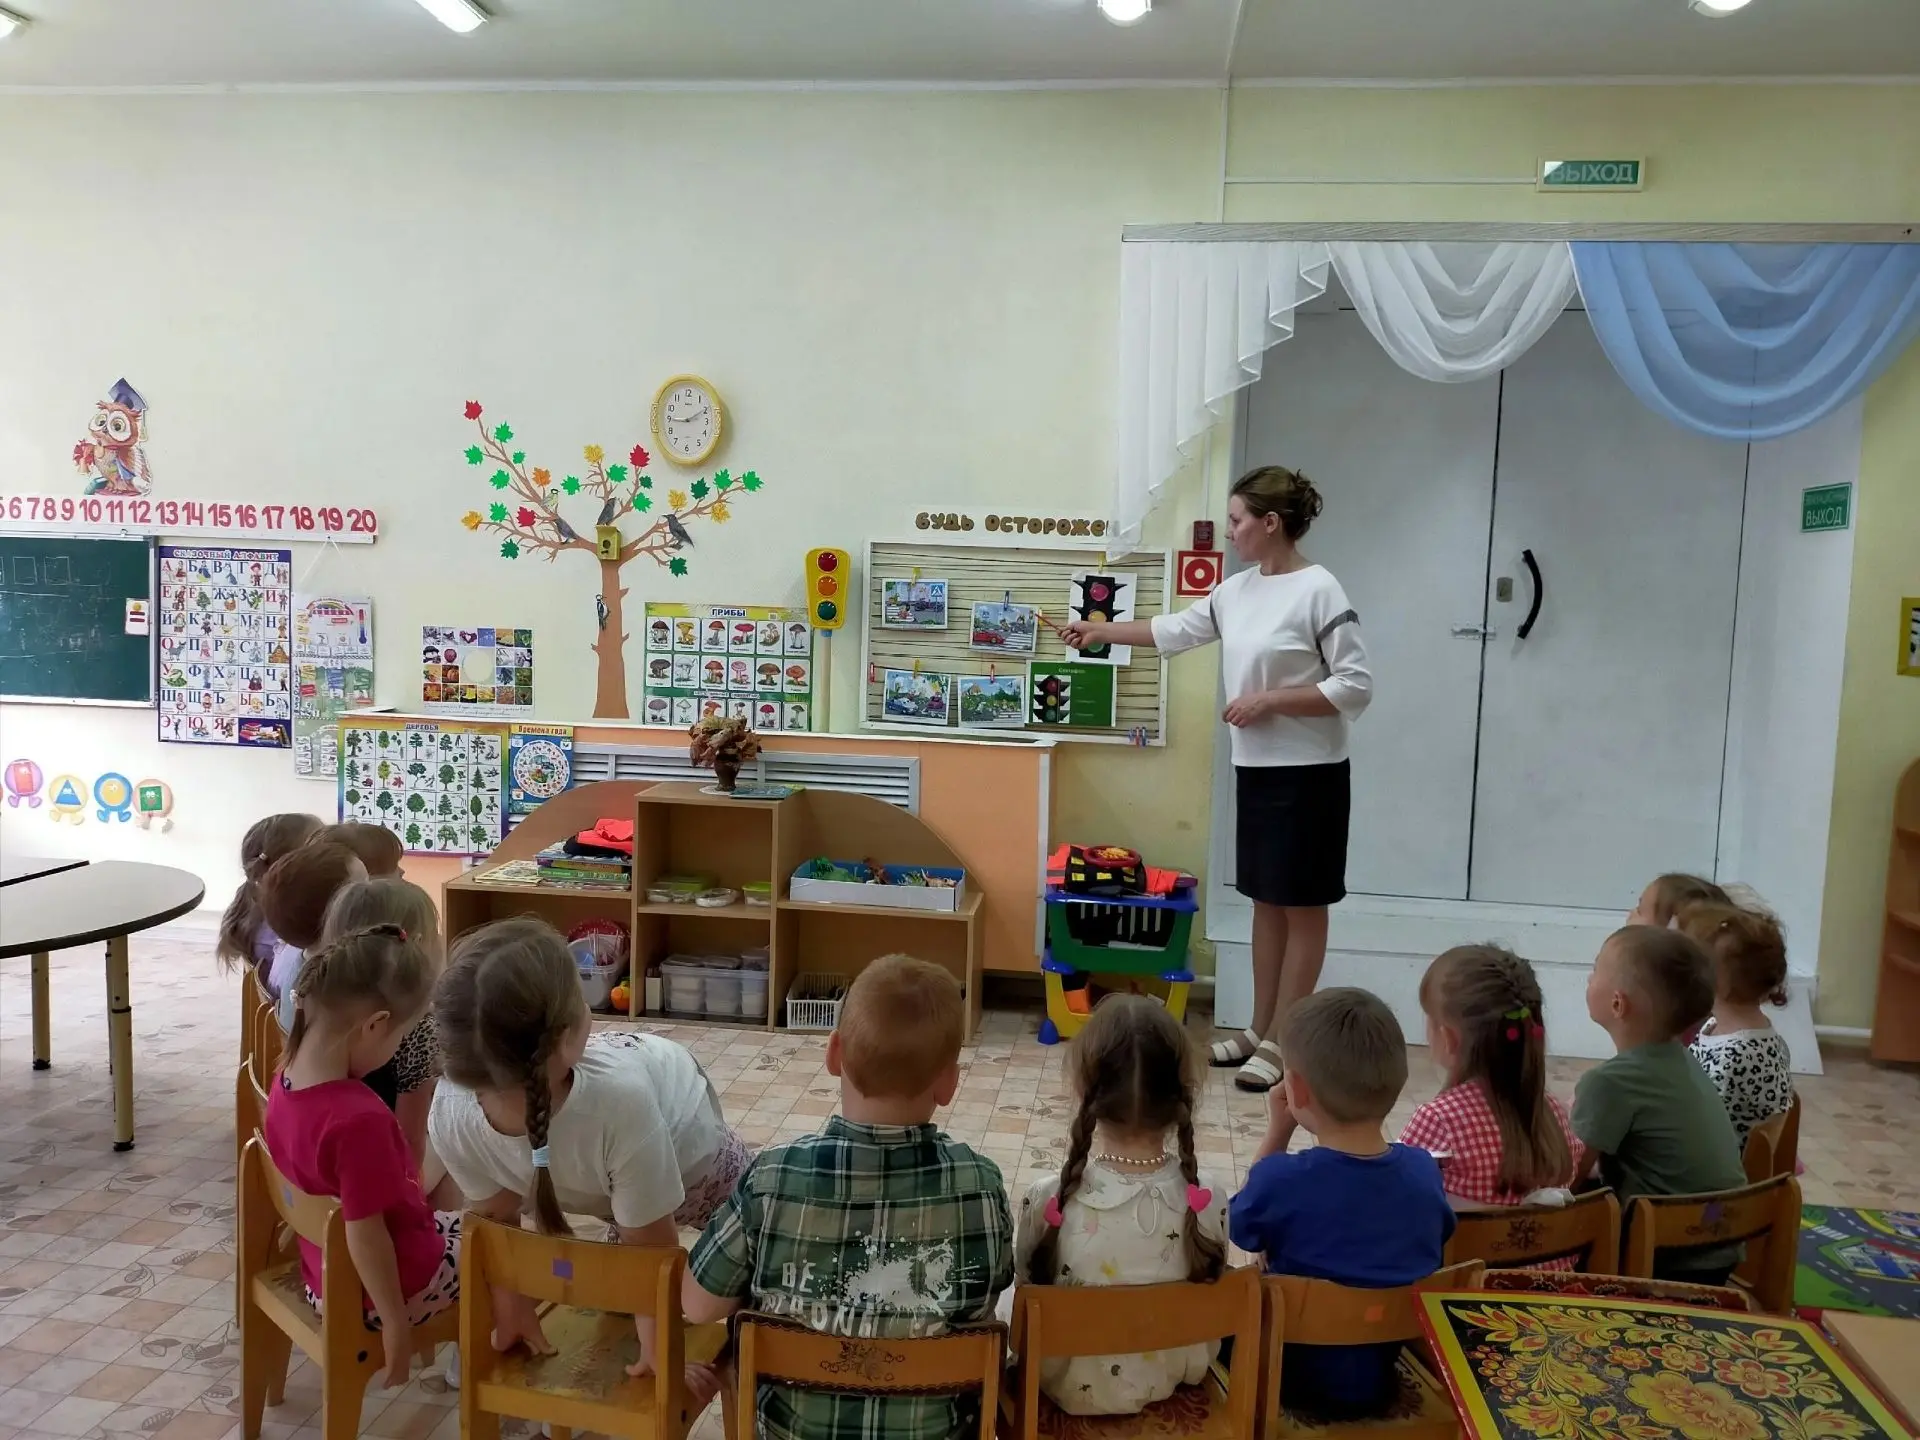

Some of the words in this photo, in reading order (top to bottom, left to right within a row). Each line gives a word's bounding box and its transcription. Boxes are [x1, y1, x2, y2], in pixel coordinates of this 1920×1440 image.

[1550, 164, 1633, 182] ВЫХОД
[9, 497, 22, 519] 6
[27, 498, 40, 520] 7
[44, 498, 56, 520] 8
[61, 499, 74, 521] 9
[79, 499, 102, 522] 10
[106, 500, 124, 523] 11
[128, 501, 152, 523] 12
[155, 501, 178, 525] 13
[182, 502, 203, 526] 14
[208, 504, 232, 527] 15
[235, 505, 257, 528] 16
[262, 506, 284, 529] 17
[290, 506, 315, 530] 18
[318, 508, 343, 531] 19
[347, 509, 377, 533] 20
[1806, 506, 1842, 526] ВЫХОД
[233, 551, 279, 560] АЛФАВИТ
[162, 561, 172, 571] А
[188, 560, 197, 572] Б
[214, 561, 222, 573] В
[240, 562, 248, 574] Г
[264, 563, 275, 576] Д
[162, 586, 171, 598] Е
[214, 588, 226, 600] Ж
[240, 589, 247, 600] З
[266, 590, 277, 602] И
[162, 610, 172, 624] Й
[190, 613, 199, 625] К
[214, 614, 226, 626] Л
[241, 615, 252, 627] М
[266, 616, 276, 628] Н
[712, 608, 746, 617] ГРИБЫ
[162, 638, 173, 650] О
[190, 639, 200, 650] П
[215, 640, 222, 651] Р
[240, 641, 250, 653] С
[265, 642, 275, 654] Т
[162, 664, 172, 675] У
[189, 665, 201, 676] Ф
[215, 666, 224, 678] Х
[241, 668, 250, 680] Ц
[266, 669, 276, 680] Ч
[162, 690, 176, 701] Ш
[214, 692, 225, 704] Ъ
[241, 694, 251, 705] Ы
[266, 694, 274, 706] Ь
[162, 716, 170, 727] Э
[189, 717, 203, 729] Ю
[215, 718, 224, 730] Я
[782, 1262, 816, 1293] BE
